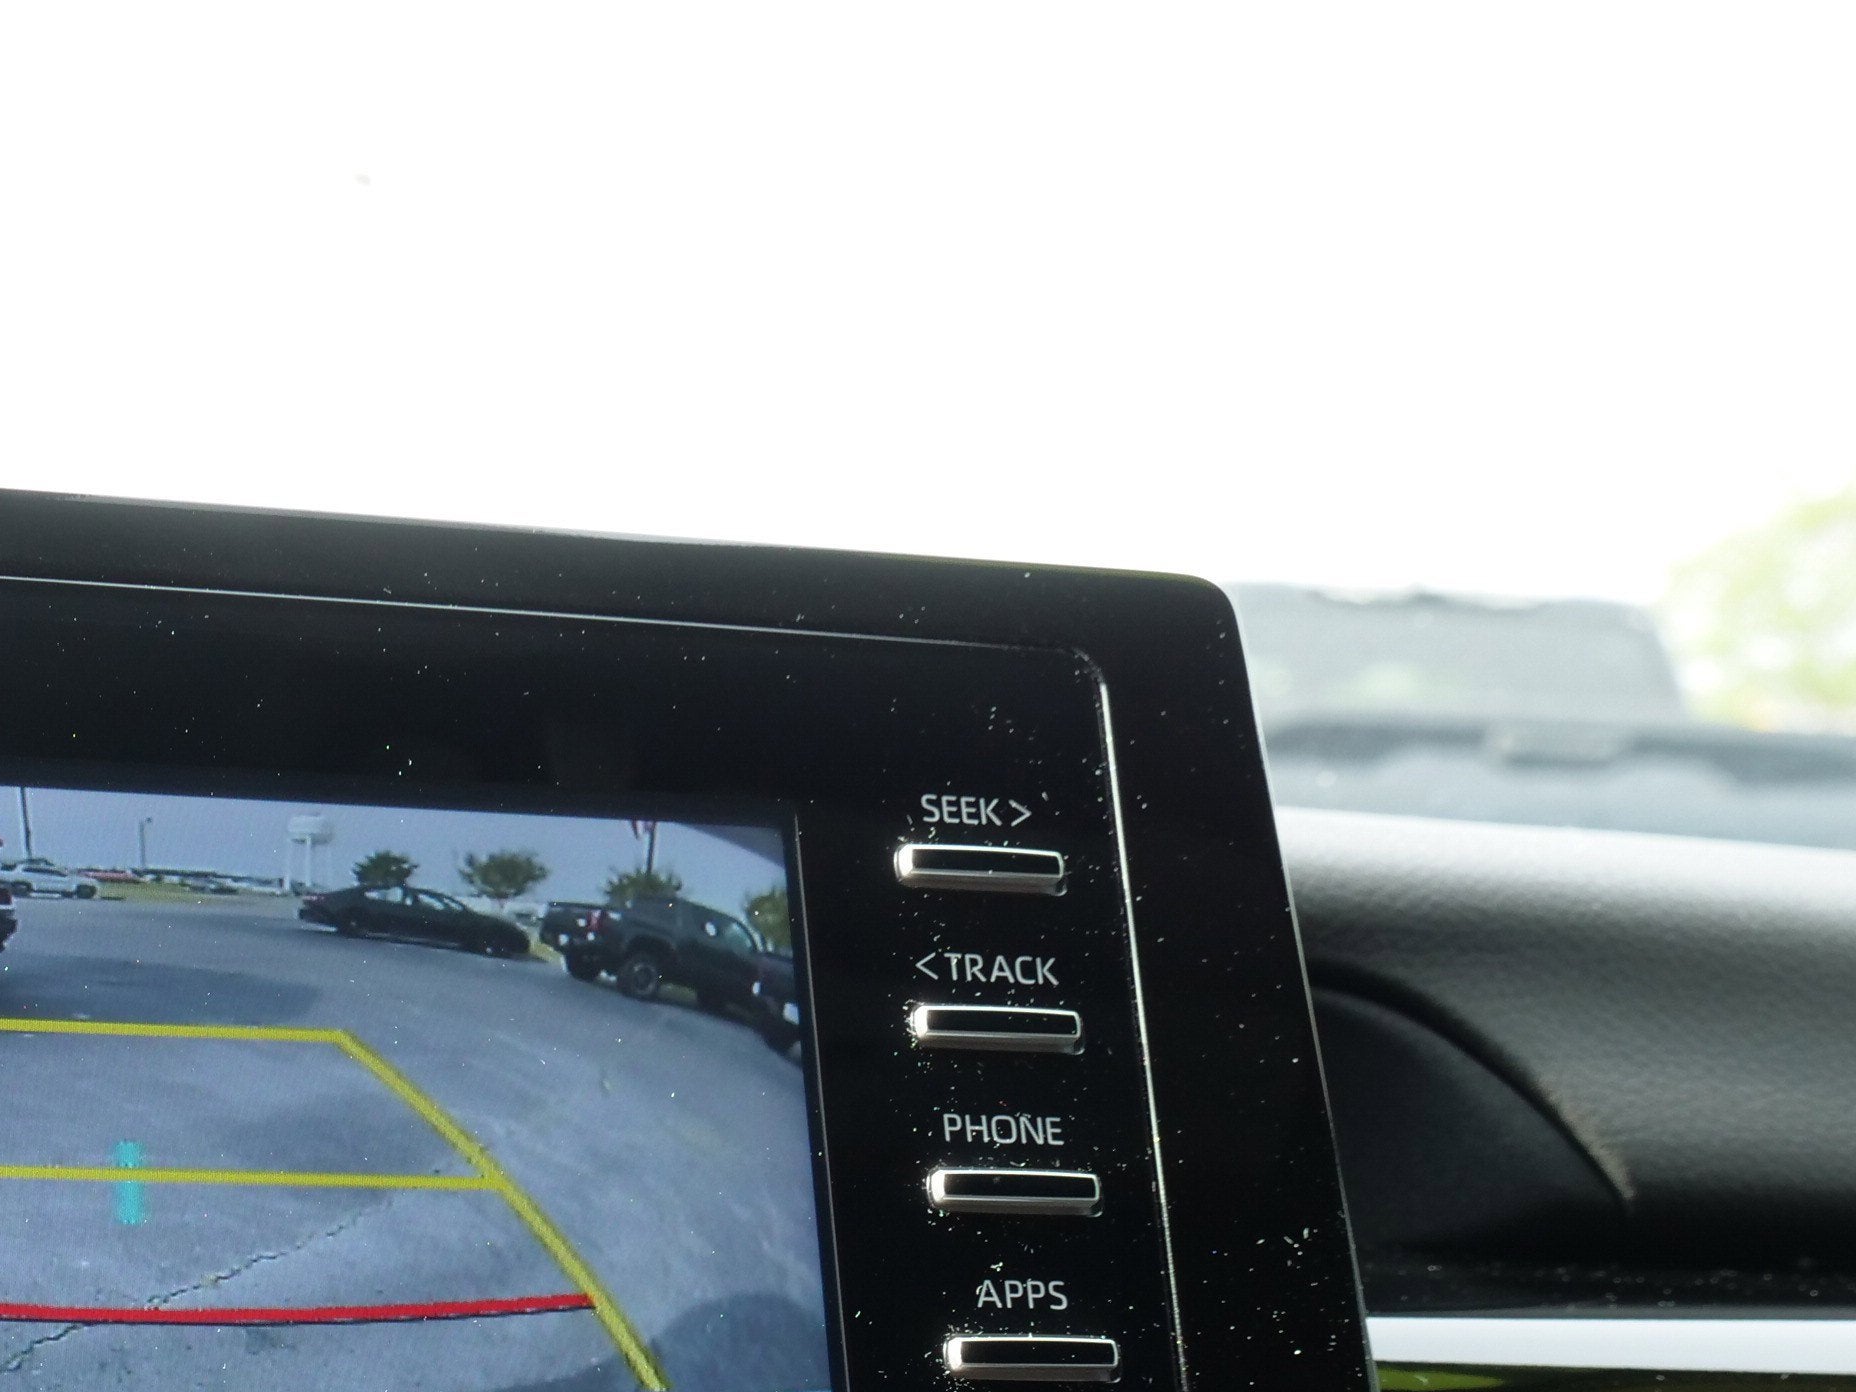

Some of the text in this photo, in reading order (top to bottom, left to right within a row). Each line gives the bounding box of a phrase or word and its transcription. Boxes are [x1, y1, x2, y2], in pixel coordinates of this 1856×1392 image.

[920, 793, 1002, 827] SEEK
[943, 952, 1060, 987] TRACK
[942, 1112, 1065, 1146] PHONE
[976, 1279, 1068, 1311] APPS
